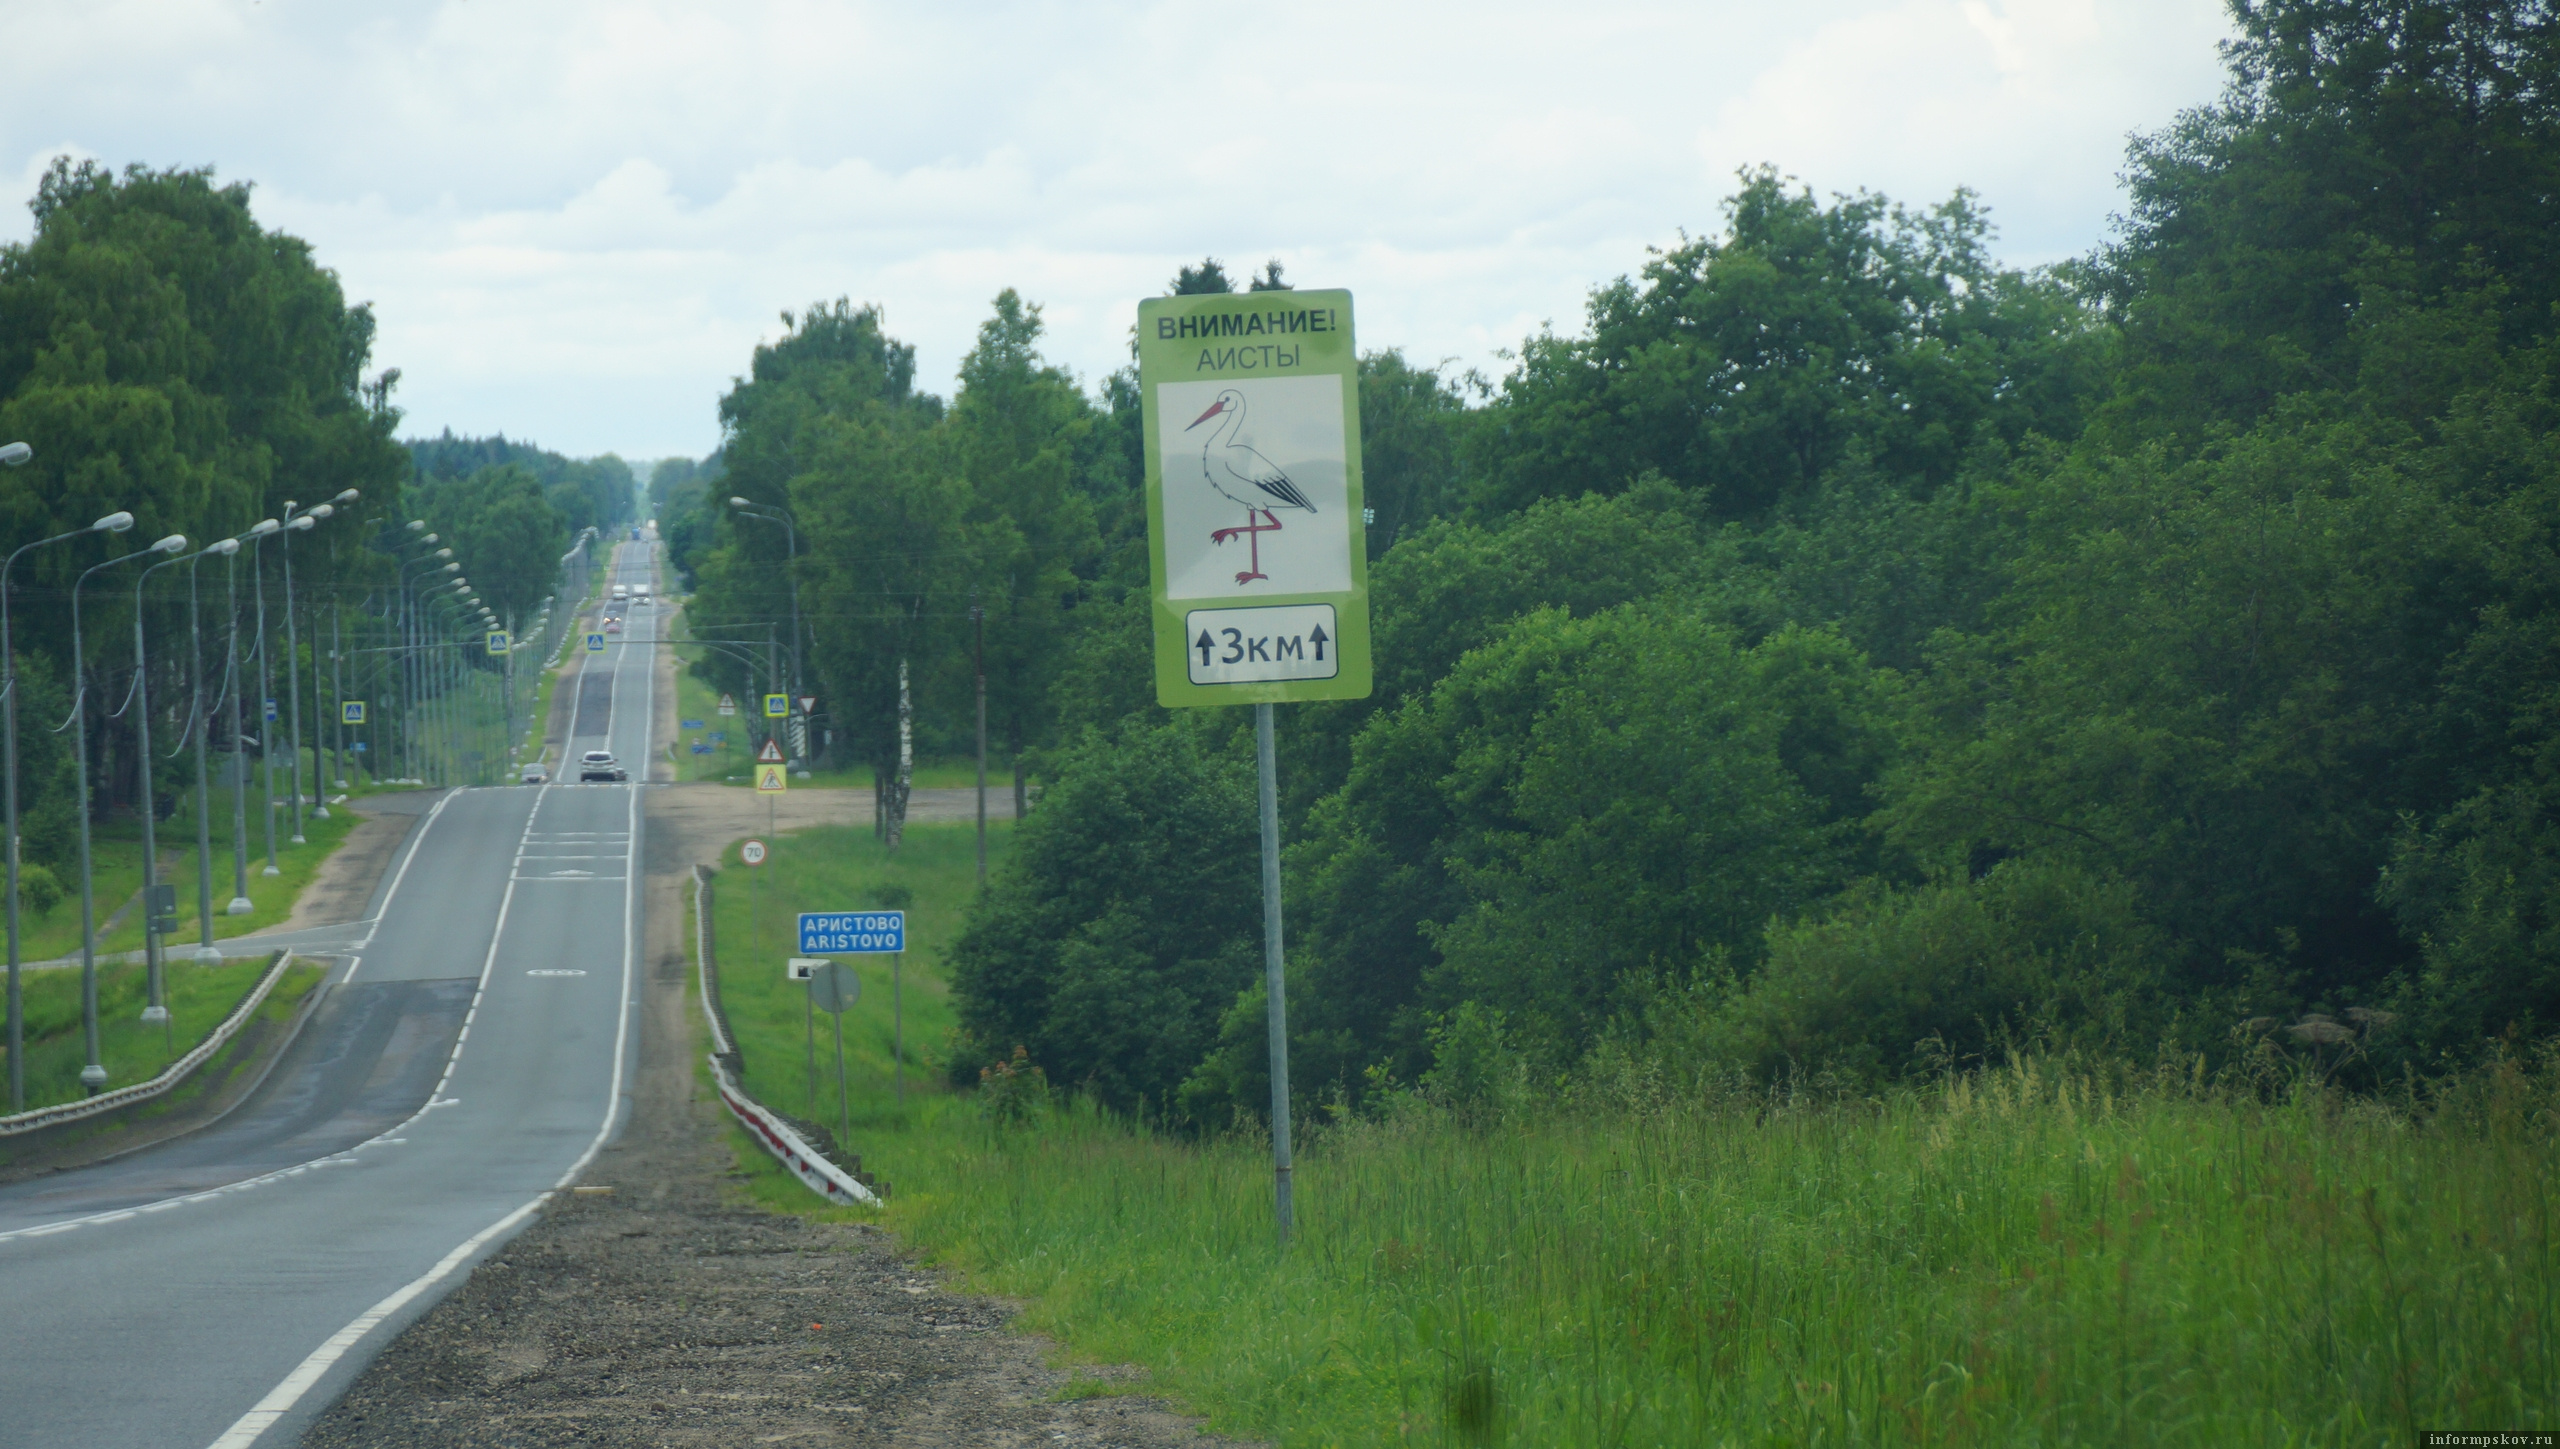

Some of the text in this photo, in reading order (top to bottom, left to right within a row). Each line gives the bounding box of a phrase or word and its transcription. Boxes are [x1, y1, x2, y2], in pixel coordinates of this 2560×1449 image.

[1157, 309, 1336, 340] ВНИМАНИЕ!
[1197, 344, 1300, 372] АИСТЫ
[747, 847, 761, 858] 70
[805, 916, 901, 932] АРИСТОВО
[806, 933, 897, 949] ARISTOVO
